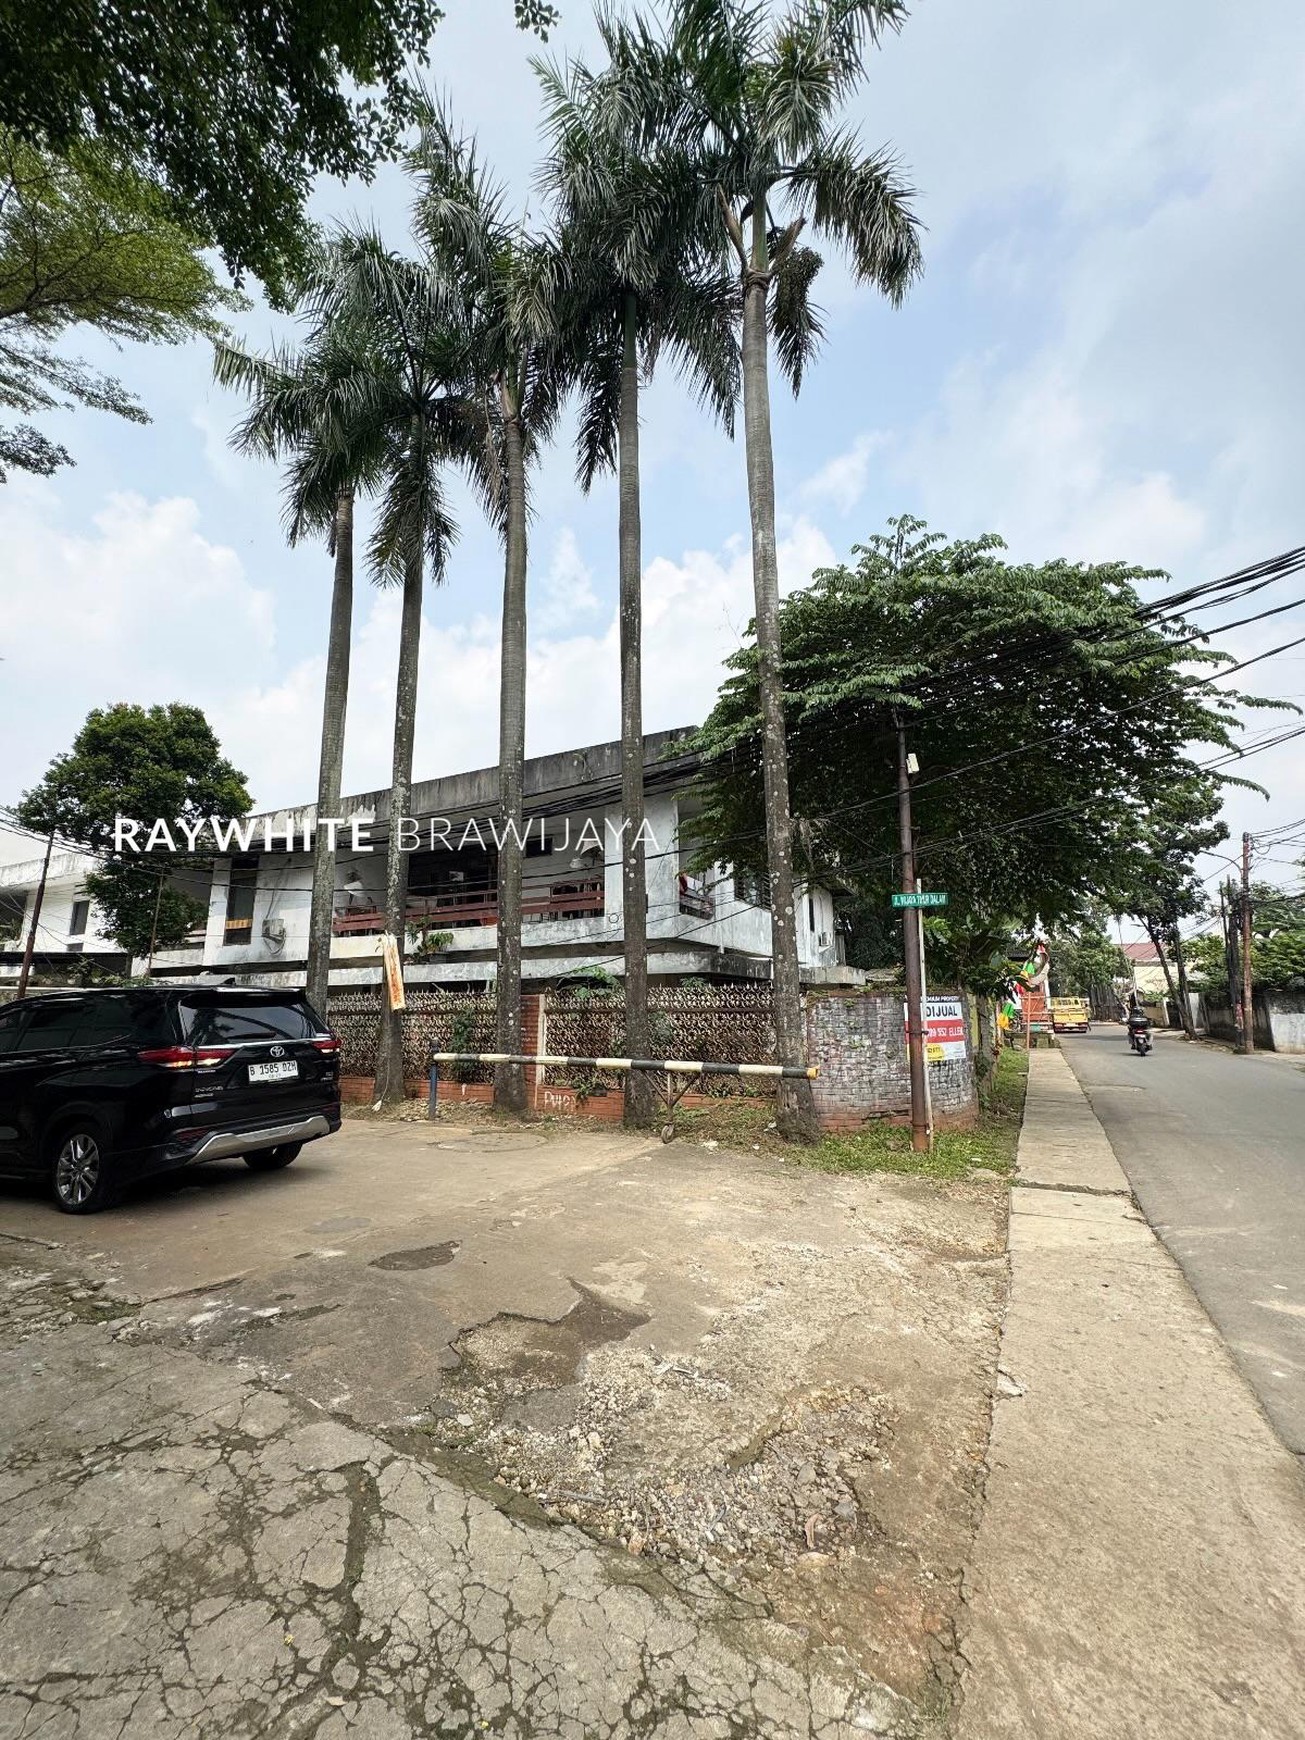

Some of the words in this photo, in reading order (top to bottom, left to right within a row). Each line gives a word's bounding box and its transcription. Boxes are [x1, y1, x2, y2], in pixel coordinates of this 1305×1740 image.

[930, 894, 945, 904] DALAM
[926, 1006, 957, 1017] DIJUAL
[250, 1066, 255, 1076] B
[259, 1063, 279, 1075] 1585
